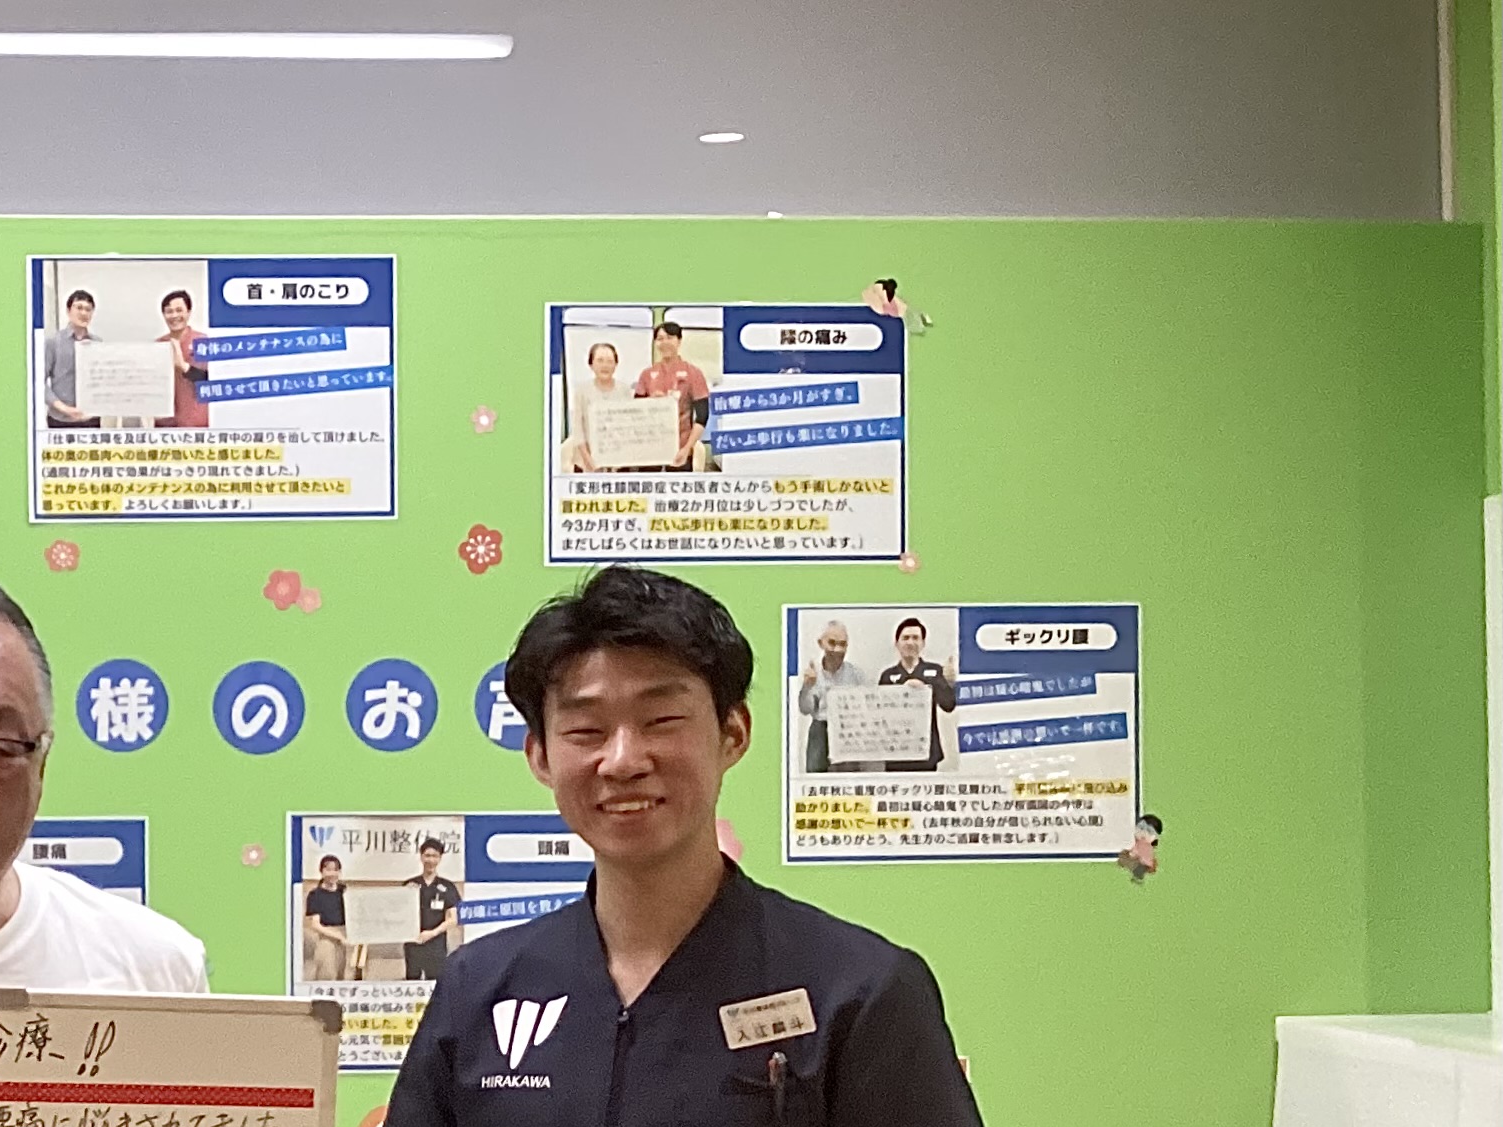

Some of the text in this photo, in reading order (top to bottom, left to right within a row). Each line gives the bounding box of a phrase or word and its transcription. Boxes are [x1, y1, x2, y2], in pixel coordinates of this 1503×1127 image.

[246, 283, 350, 301] 首・肩のこり
[537, 840, 570, 856] 頭痛
[481, 1074, 551, 1090] HIRAKAWA
